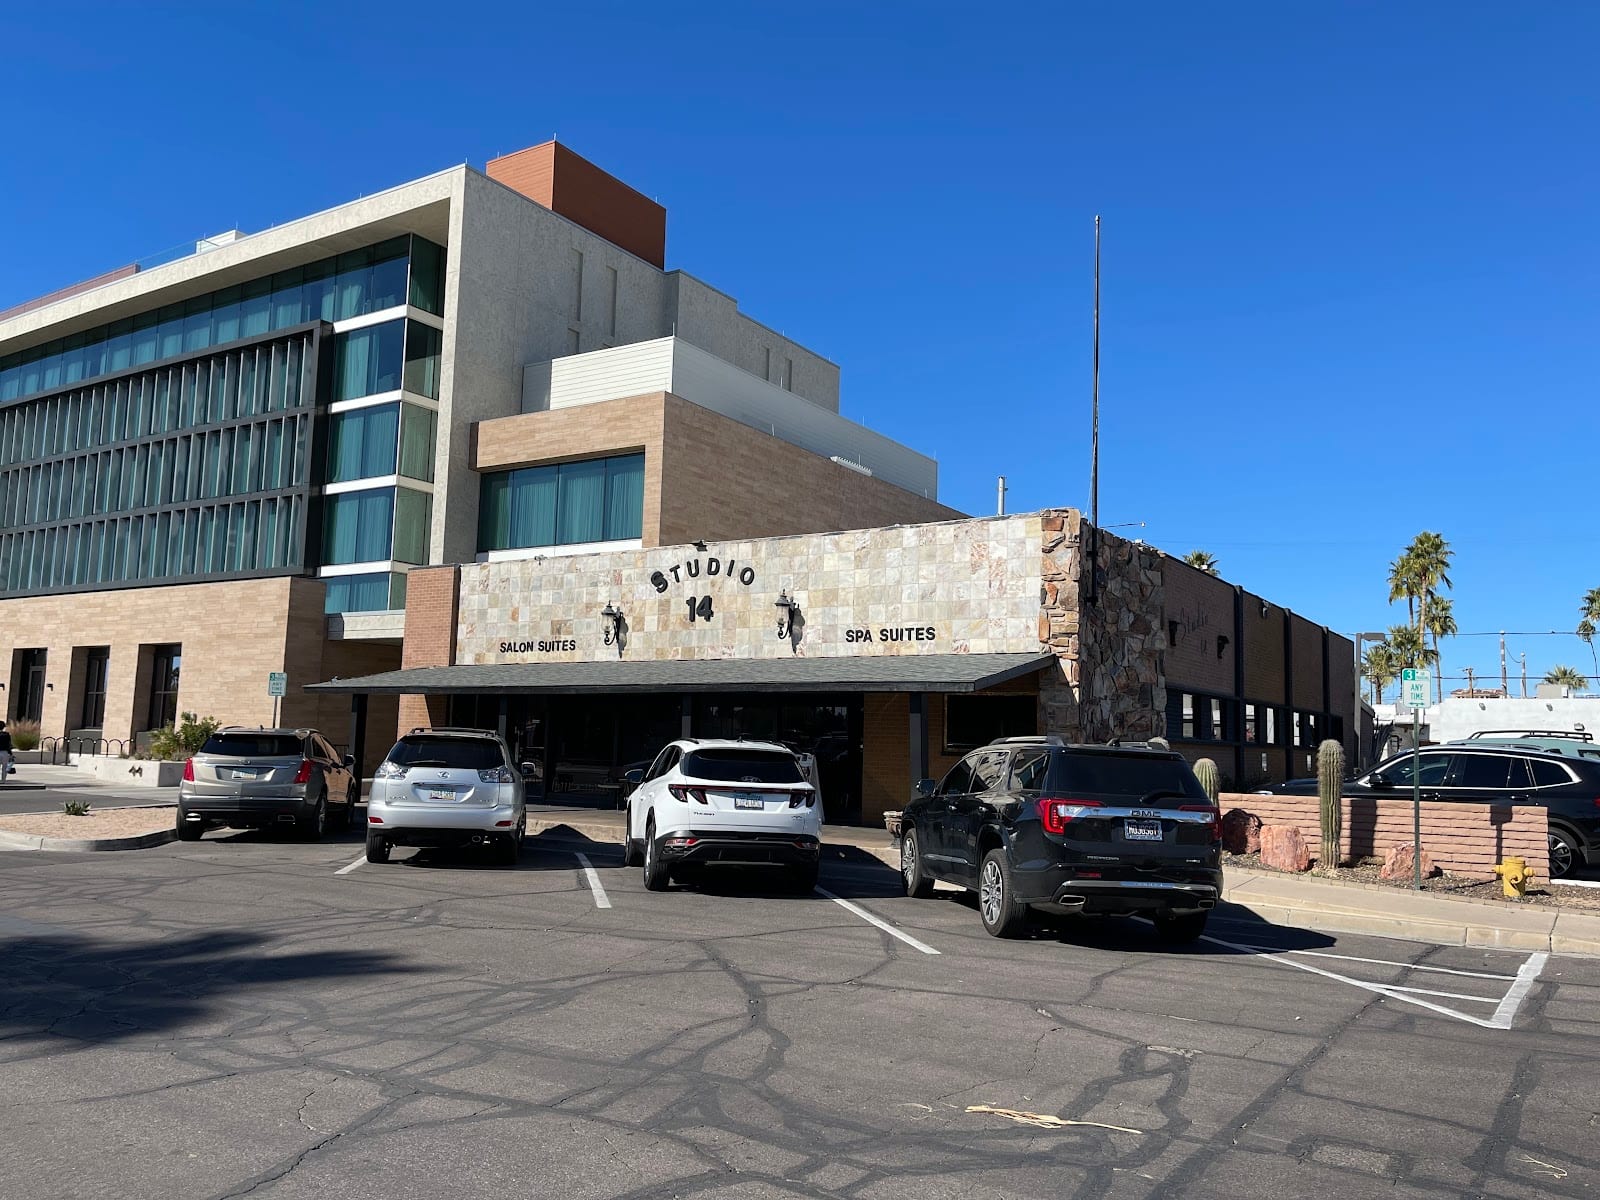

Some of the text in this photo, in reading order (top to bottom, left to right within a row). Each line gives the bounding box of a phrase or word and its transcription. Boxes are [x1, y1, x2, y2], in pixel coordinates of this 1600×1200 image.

[650, 557, 755, 594] STUDIO
[685, 595, 714, 622] 14
[845, 626, 936, 643] SPA SUITES
[499, 639, 576, 653] SALON SUITES
[1406, 670, 1413, 680] 3
[1410, 683, 1424, 691] ANY
[1410, 692, 1424, 700] TIME
